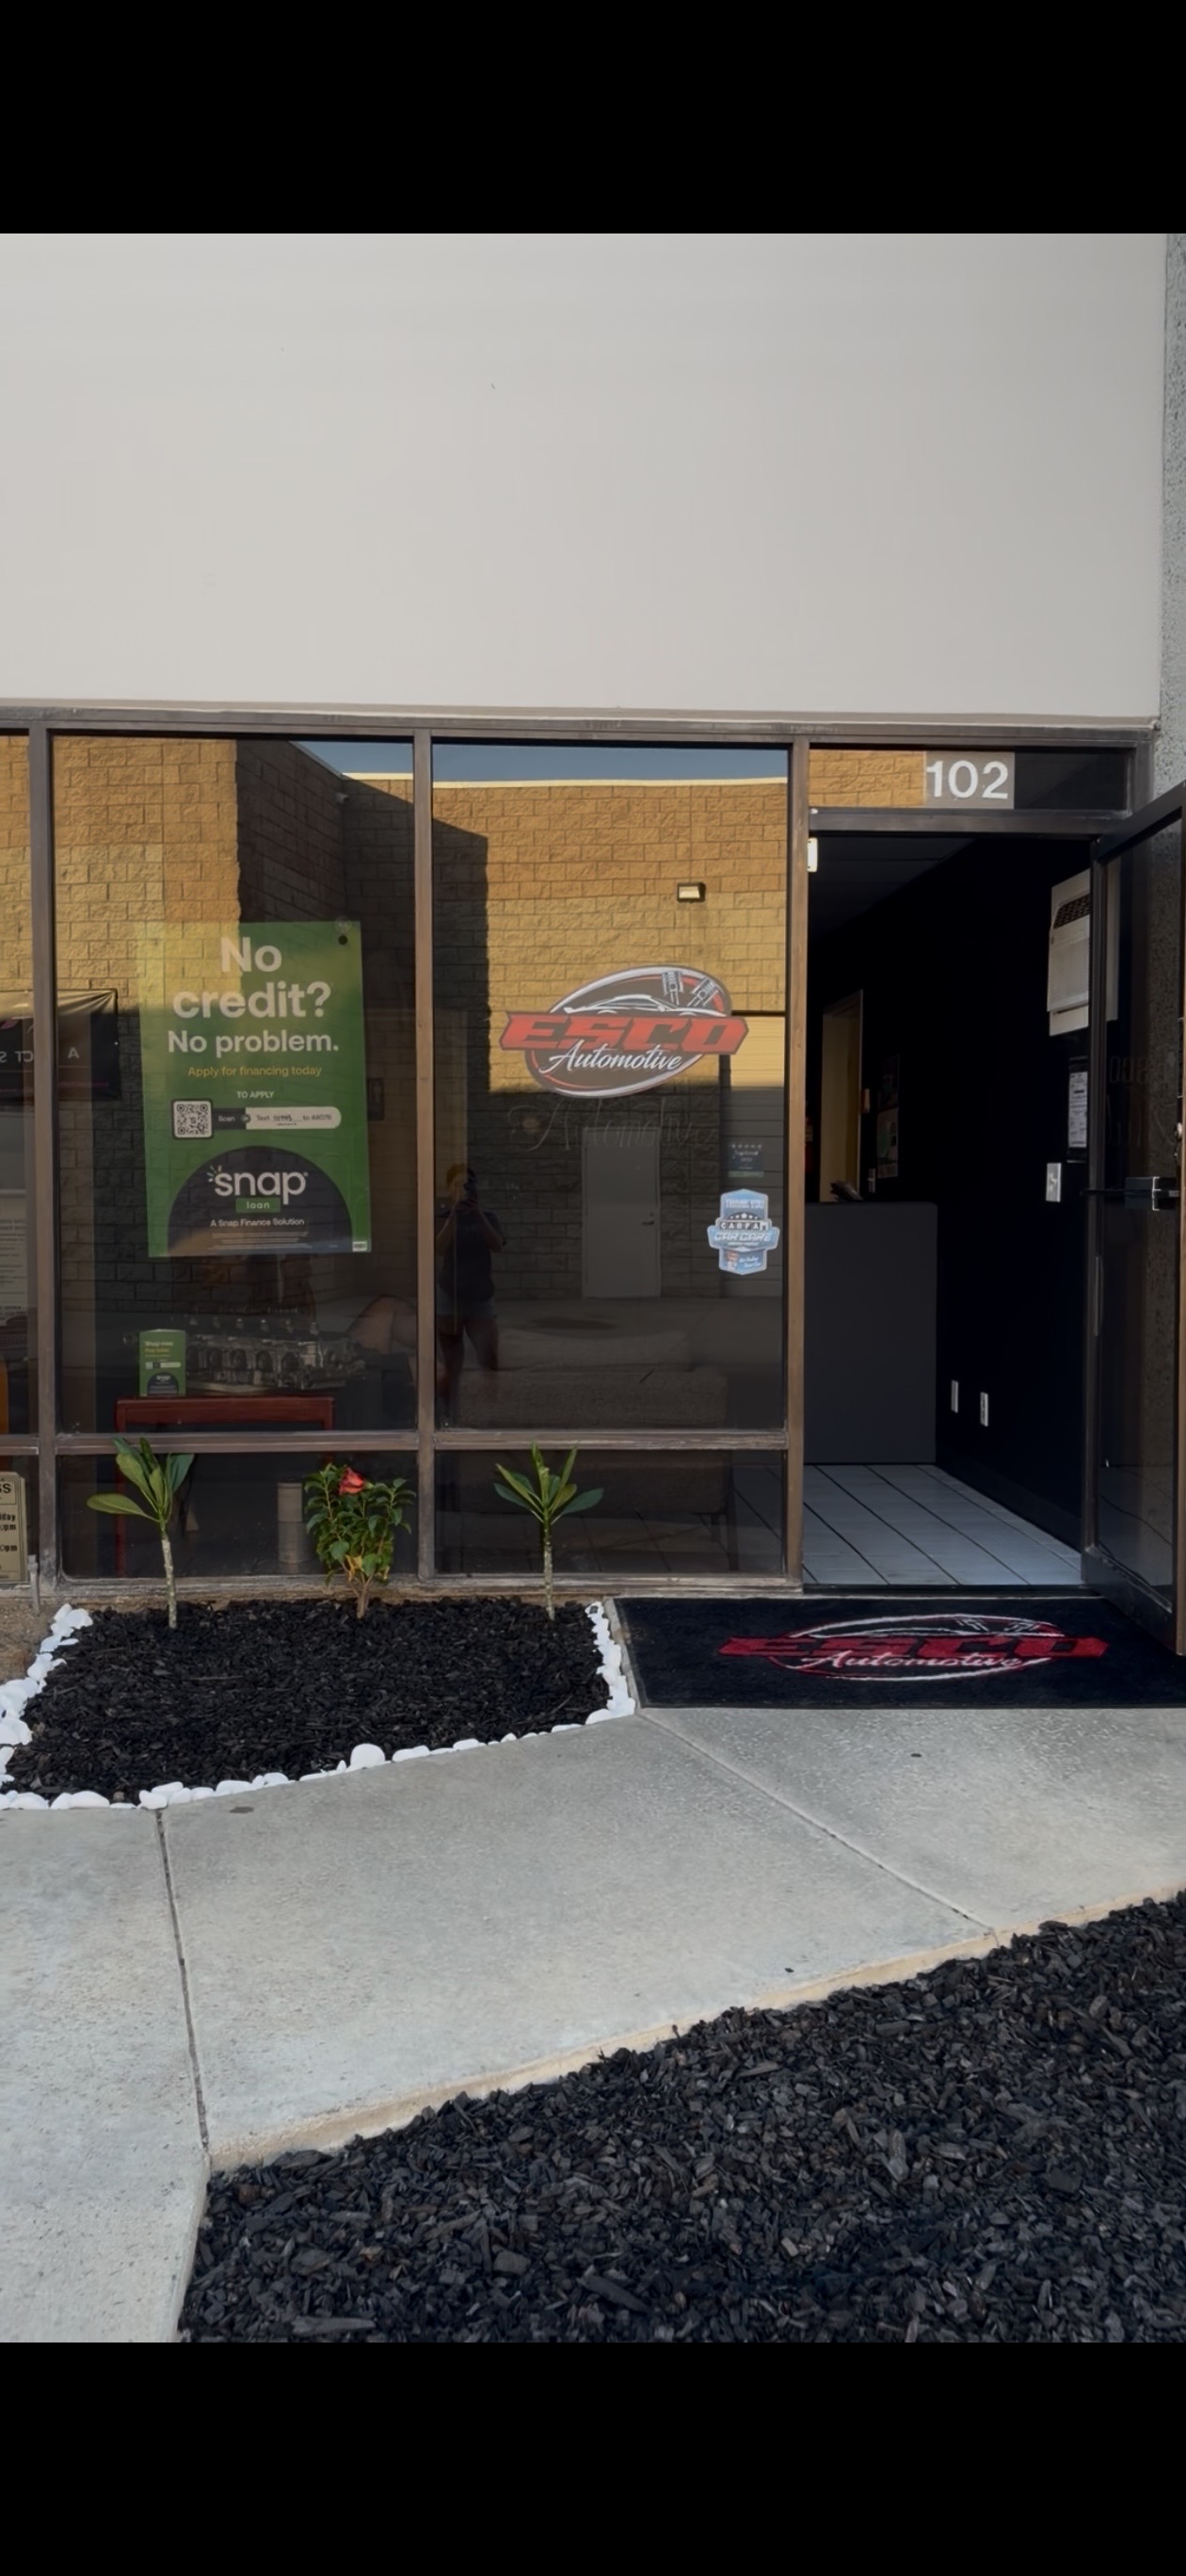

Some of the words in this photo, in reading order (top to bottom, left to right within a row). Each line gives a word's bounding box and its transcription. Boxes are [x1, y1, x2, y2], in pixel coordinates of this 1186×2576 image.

[926, 760, 1009, 799] 102
[221, 937, 282, 973] No
[172, 980, 331, 1018] credit?
[168, 1030, 207, 1053] No
[216, 1030, 339, 1058] problem.
[500, 1013, 747, 1053] ESCO
[538, 1038, 683, 1074] Automotive
[188, 1067, 219, 1078] Apply
[221, 1066, 236, 1076] for
[239, 1066, 288, 1078] financing
[291, 1066, 322, 1077] today
[236, 1090, 248, 1099] TO
[249, 1090, 275, 1099] APPLY
[215, 1171, 307, 1205] snap
[246, 1201, 270, 1210] loan
[210, 1219, 217, 1228] A
[217, 1219, 239, 1229] Snap
[240, 1218, 271, 1228] Finance
[272, 1217, 305, 1227] Solution
[718, 1636, 1110, 1658] ESCO
[785, 1650, 1025, 1670] Automotive
